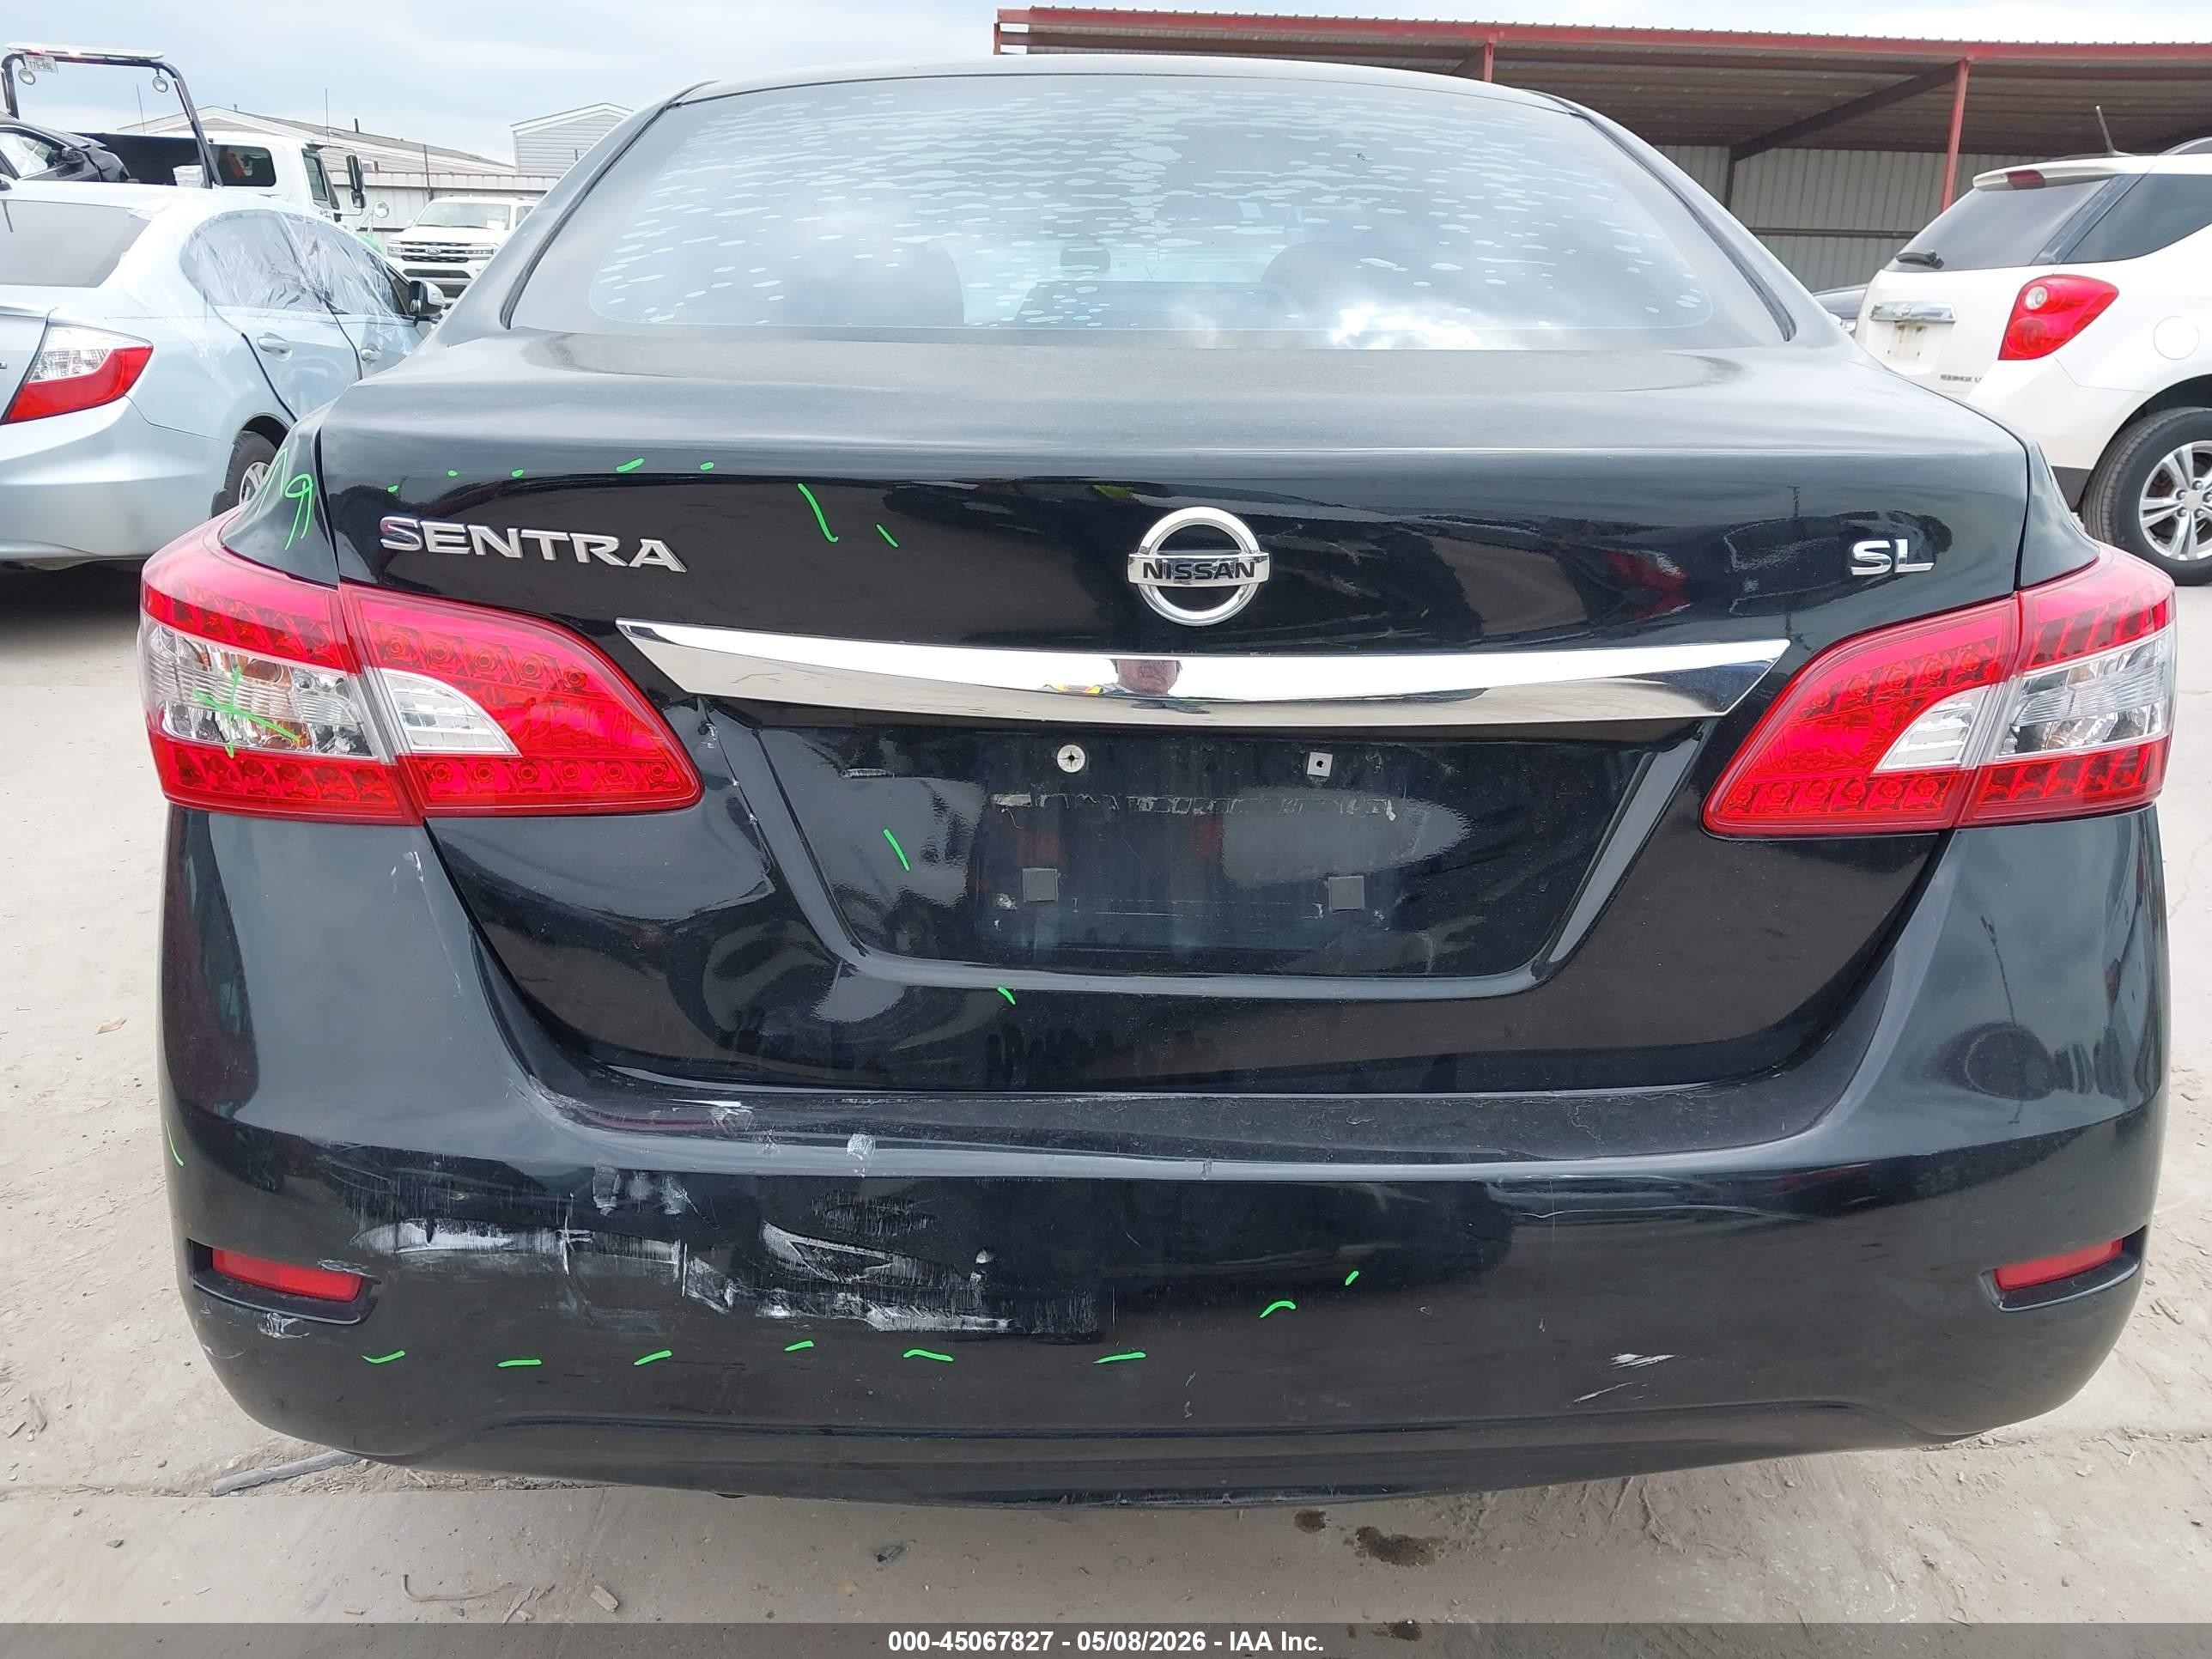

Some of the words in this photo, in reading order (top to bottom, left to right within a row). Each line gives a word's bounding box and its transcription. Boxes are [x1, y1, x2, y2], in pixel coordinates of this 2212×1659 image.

[380, 515, 687, 573] SENTRA
[1850, 538, 1935, 576] SL
[1143, 562, 1255, 580] NISSAN
